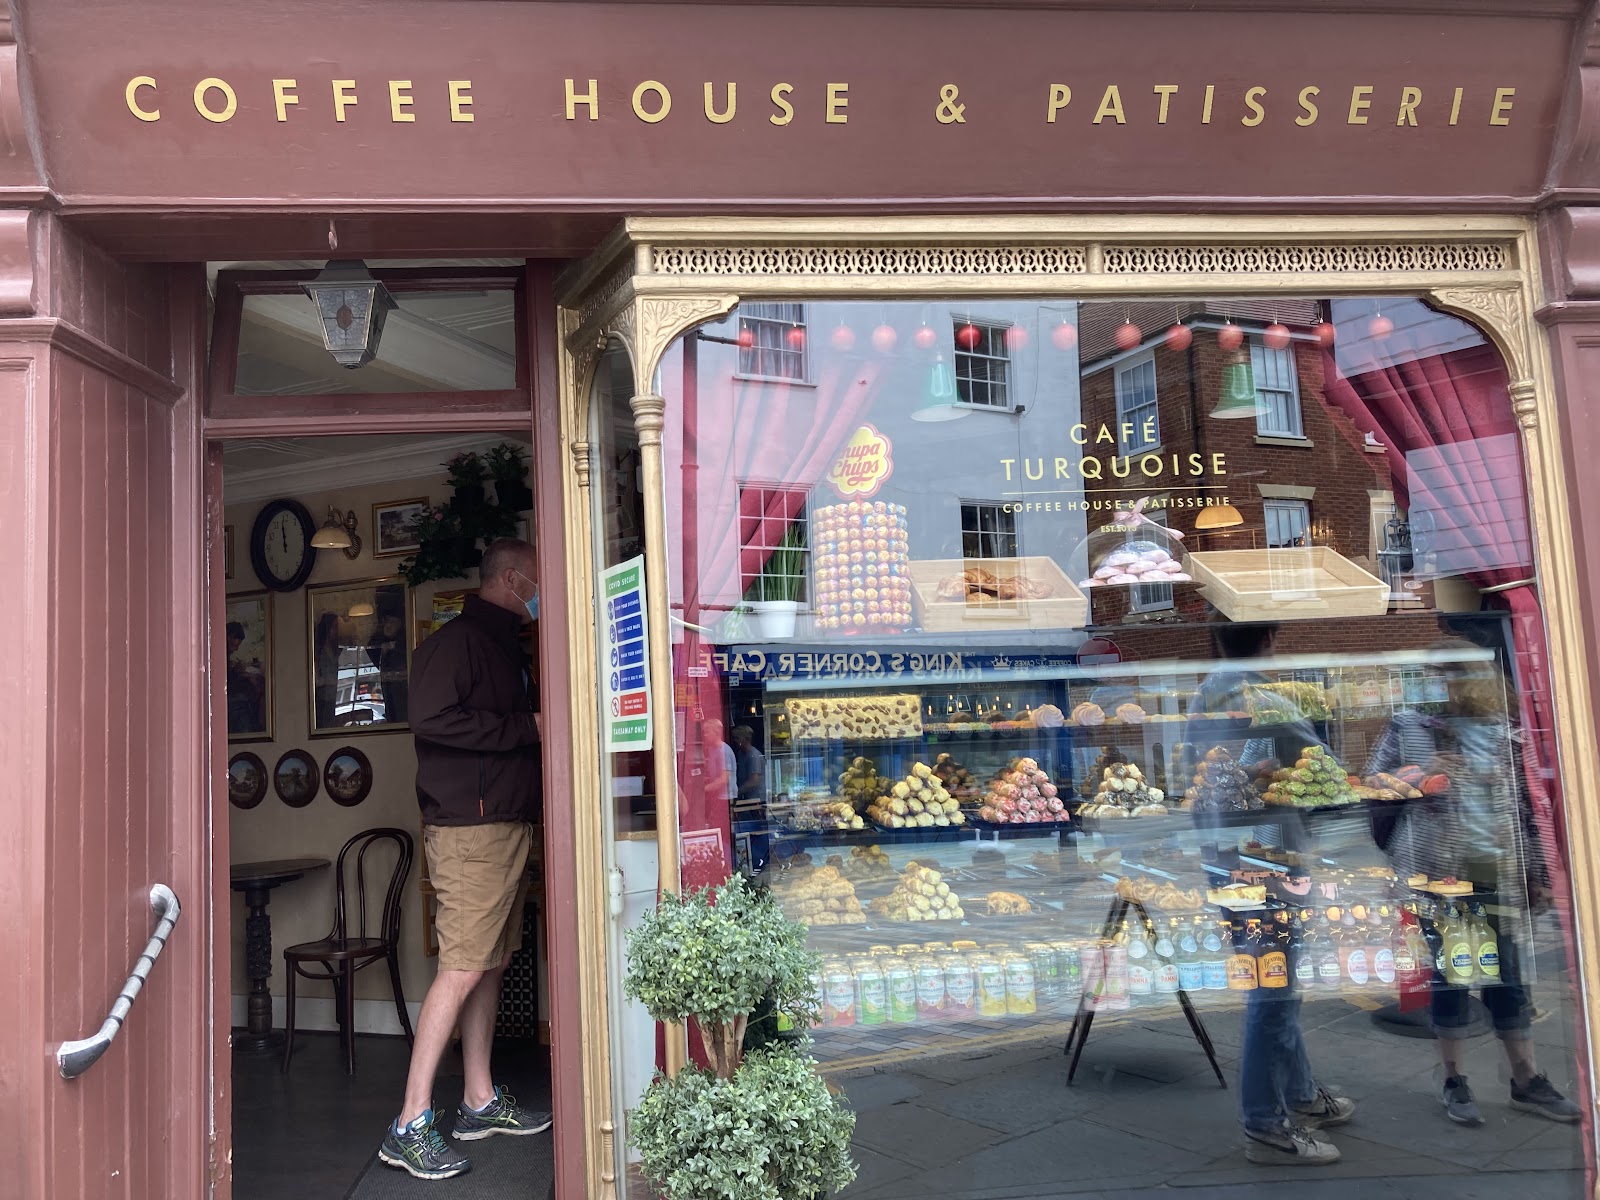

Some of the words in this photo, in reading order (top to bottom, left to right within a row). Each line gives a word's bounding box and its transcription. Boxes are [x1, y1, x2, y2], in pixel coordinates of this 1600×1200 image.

[125, 75, 476, 123] COFFEE
[564, 79, 849, 126] HOUSE
[935, 83, 967, 125] &
[1046, 83, 1517, 127] PATISSERIE
[1070, 416, 1156, 444] CAFÉ
[837, 442, 881, 461] hupa
[1000, 453, 1227, 481] TURQUOISE
[1002, 502, 1062, 514] COFFEE
[1068, 500, 1122, 511] HOUSE
[1143, 496, 1231, 509] PATISSERIE
[608, 580, 620, 590] COVID
[621, 574, 636, 586] SECURE
[613, 727, 633, 736] TAKEAWAY
[634, 725, 646, 734] ONLY
